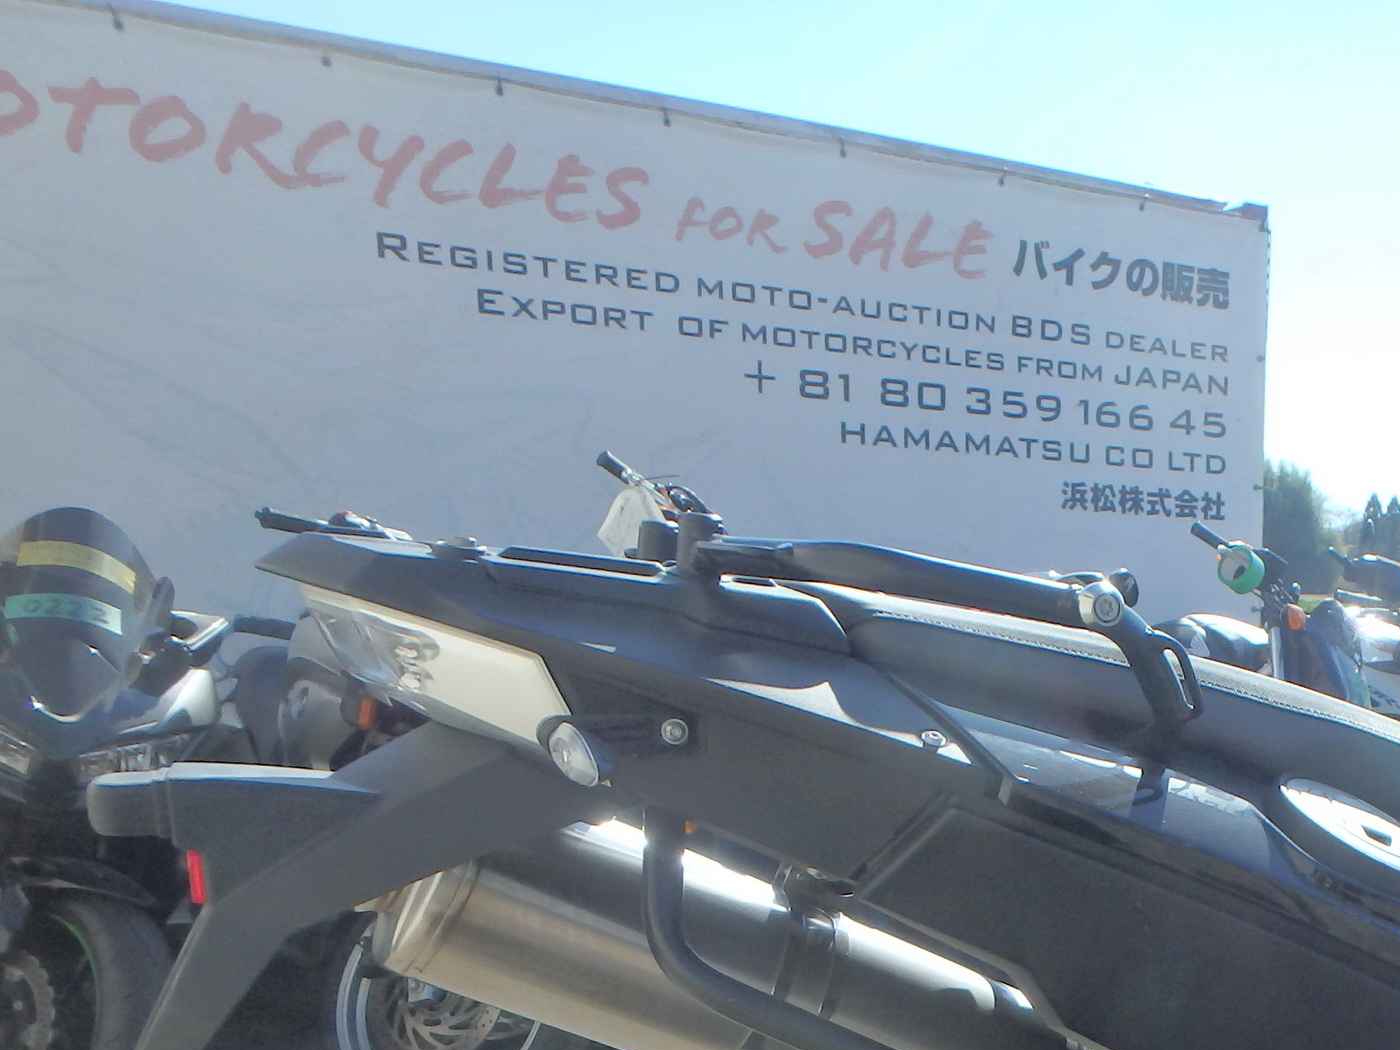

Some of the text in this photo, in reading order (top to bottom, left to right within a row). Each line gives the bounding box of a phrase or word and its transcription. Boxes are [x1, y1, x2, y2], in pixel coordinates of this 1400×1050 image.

[675, 197, 789, 254] FOR
[804, 200, 994, 279] SALE
[376, 231, 1229, 362] REGISTERED MOTO-AUCTION BDS DEALER
[1012, 239, 1230, 309] バイクの販売
[477, 288, 1228, 396] EXPORT OF MOTORCYCLES FROM JAPAN
[799, 369, 850, 402] 81
[880, 377, 946, 411] 80
[965, 387, 1062, 422] 359
[1076, 399, 1153, 431] 166
[1169, 410, 1227, 438] 45
[840, 421, 1226, 474] HAMAMATSU CO LTD
[1060, 481, 1226, 521] 浜松株式会社
